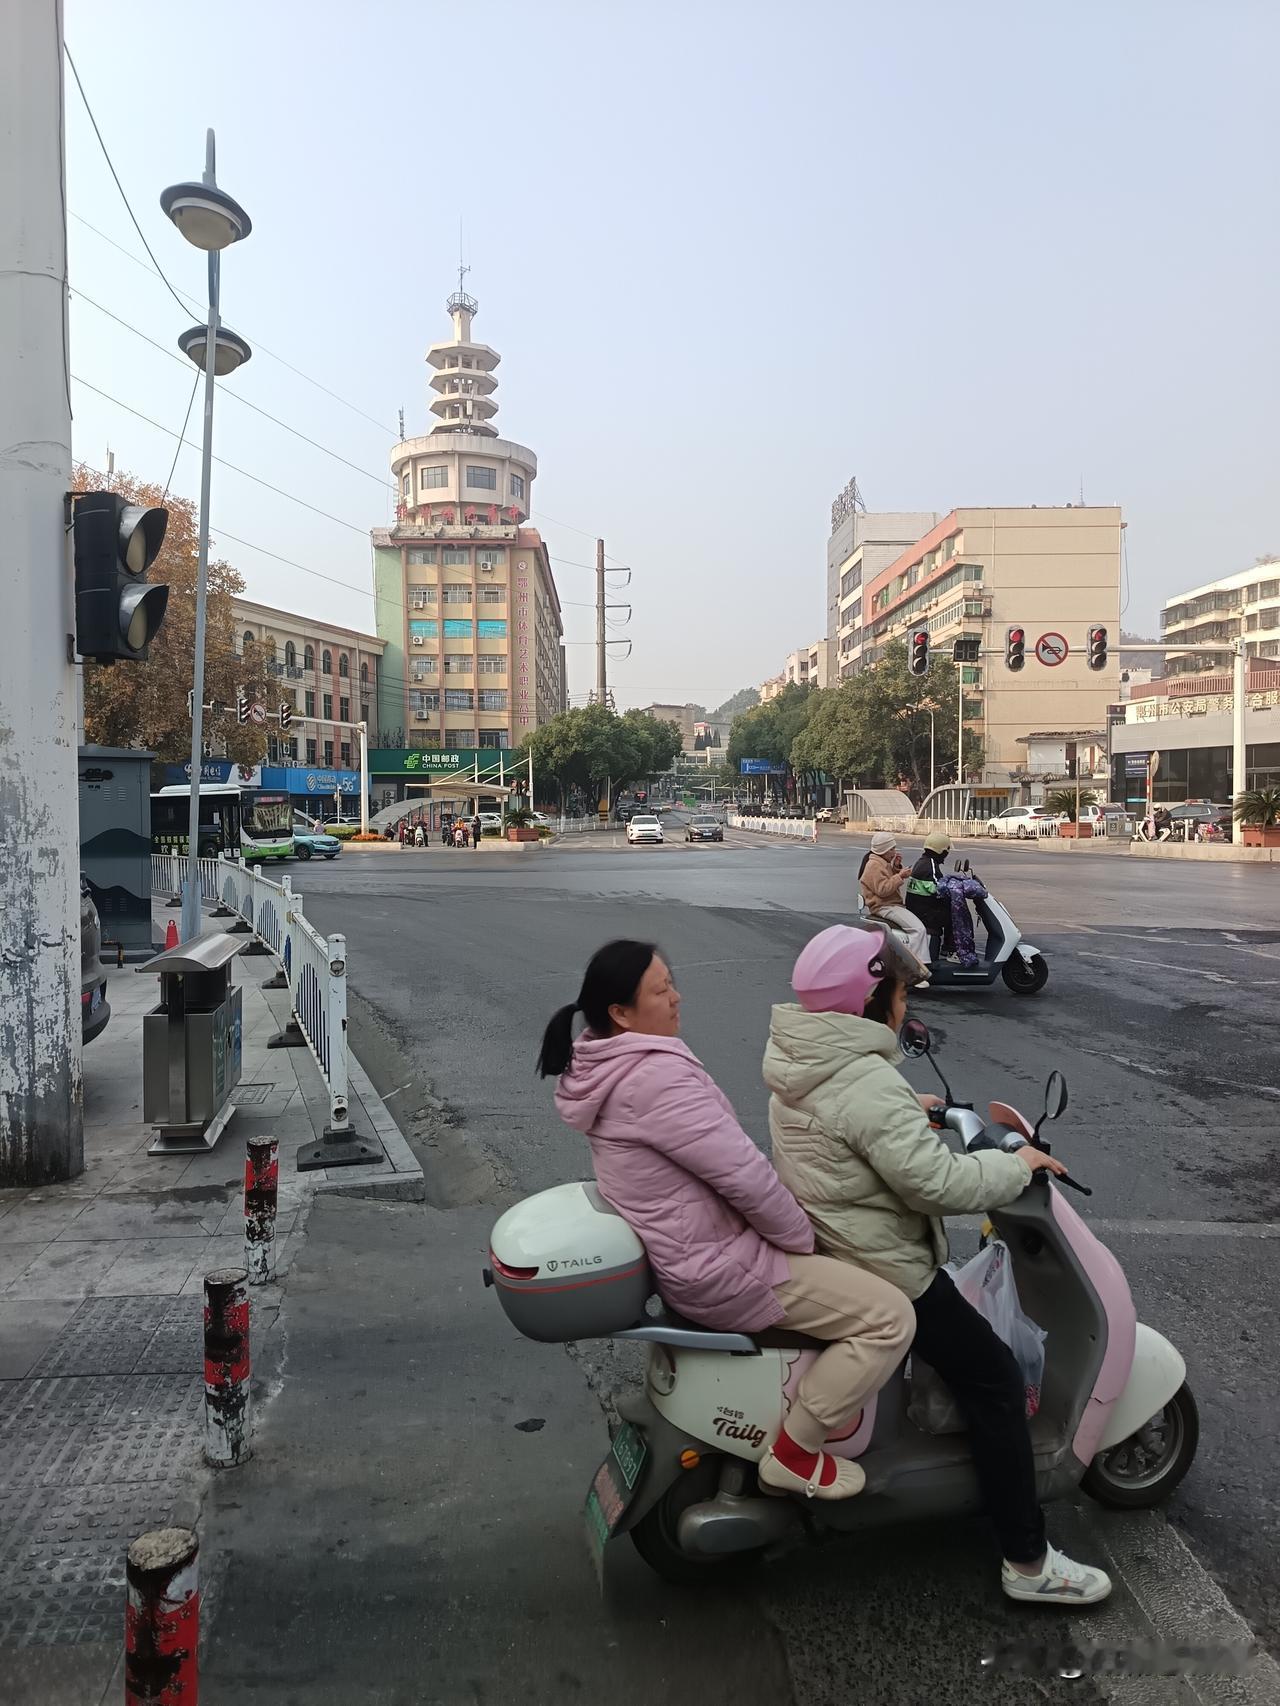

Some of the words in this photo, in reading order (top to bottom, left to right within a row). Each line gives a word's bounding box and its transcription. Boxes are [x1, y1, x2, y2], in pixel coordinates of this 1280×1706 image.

[517, 577, 529, 726] 鄂州市体育艺术职业高中
[422, 754, 460, 763] 中国邮政
[561, 1255, 603, 1269] TAILG
[713, 1417, 768, 1449] Tailg
